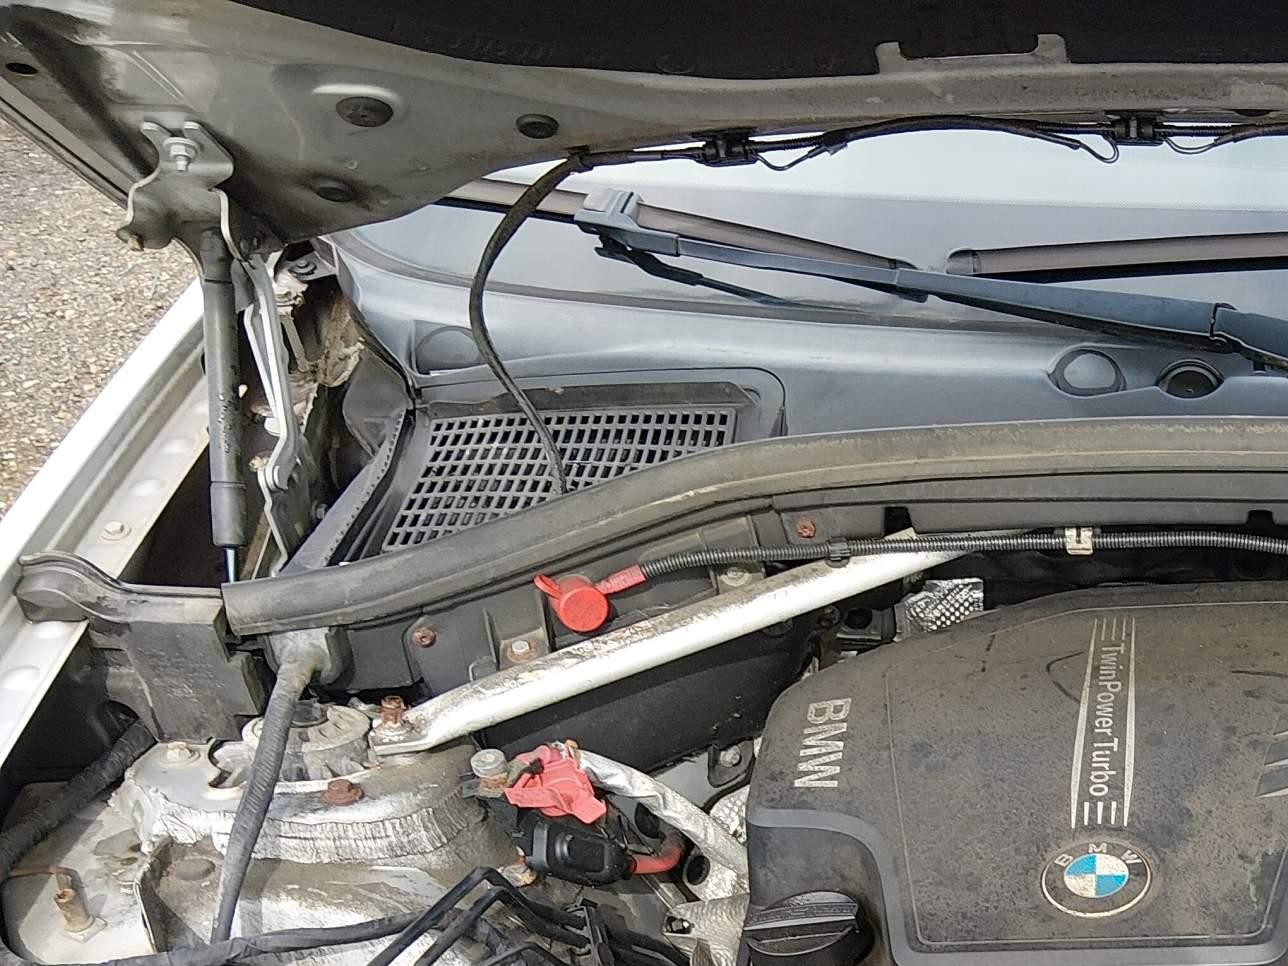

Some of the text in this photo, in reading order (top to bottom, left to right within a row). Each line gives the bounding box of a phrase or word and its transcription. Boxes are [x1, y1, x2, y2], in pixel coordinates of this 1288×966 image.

[793, 698, 851, 788] BMW
[1089, 643, 1124, 797] TwinPowerTurbo
[1054, 842, 1143, 868] BMW
